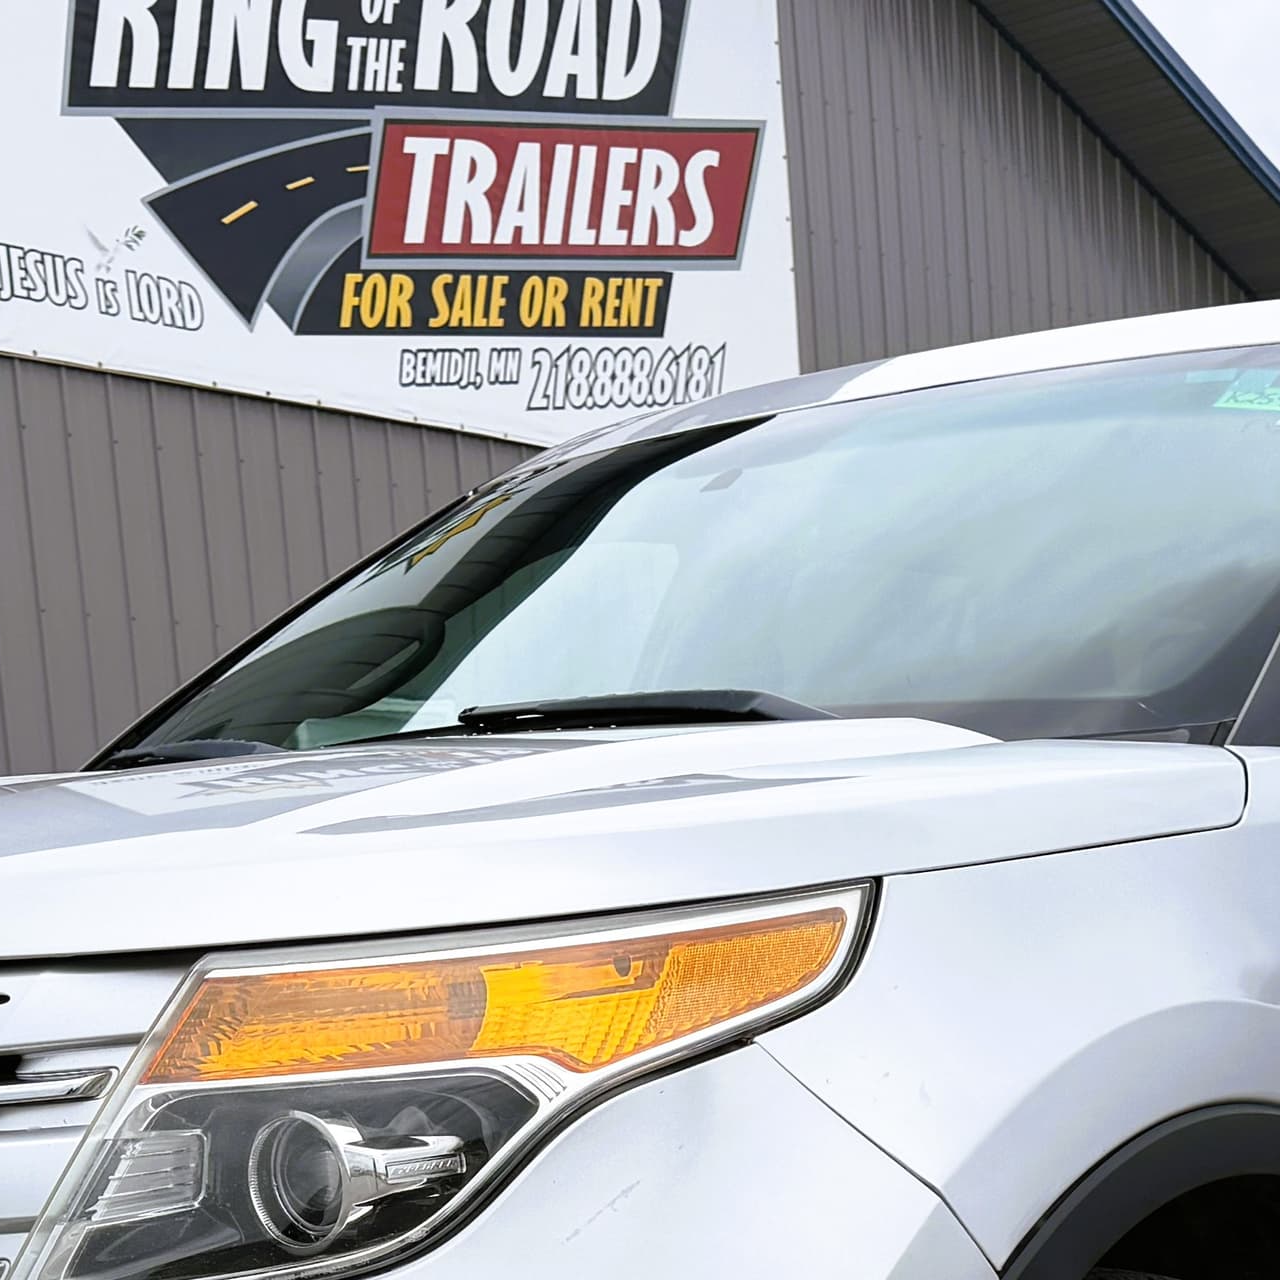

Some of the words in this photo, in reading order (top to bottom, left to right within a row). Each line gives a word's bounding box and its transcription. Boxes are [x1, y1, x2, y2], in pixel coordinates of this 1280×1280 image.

[346, 36, 407, 93] THE
[413, 0, 663, 100] ROAD
[402, 136, 721, 249] TRAILERS
[95, 278, 121, 316] IS
[125, 269, 205, 331] LORD
[339, 272, 415, 329] FOR
[428, 273, 510, 328] SALE
[519, 275, 569, 328] OR
[579, 277, 664, 328] RENT
[399, 347, 483, 389] BEMIDJI,
[487, 347, 522, 385] MN
[526, 342, 727, 411] 218.888.6181
